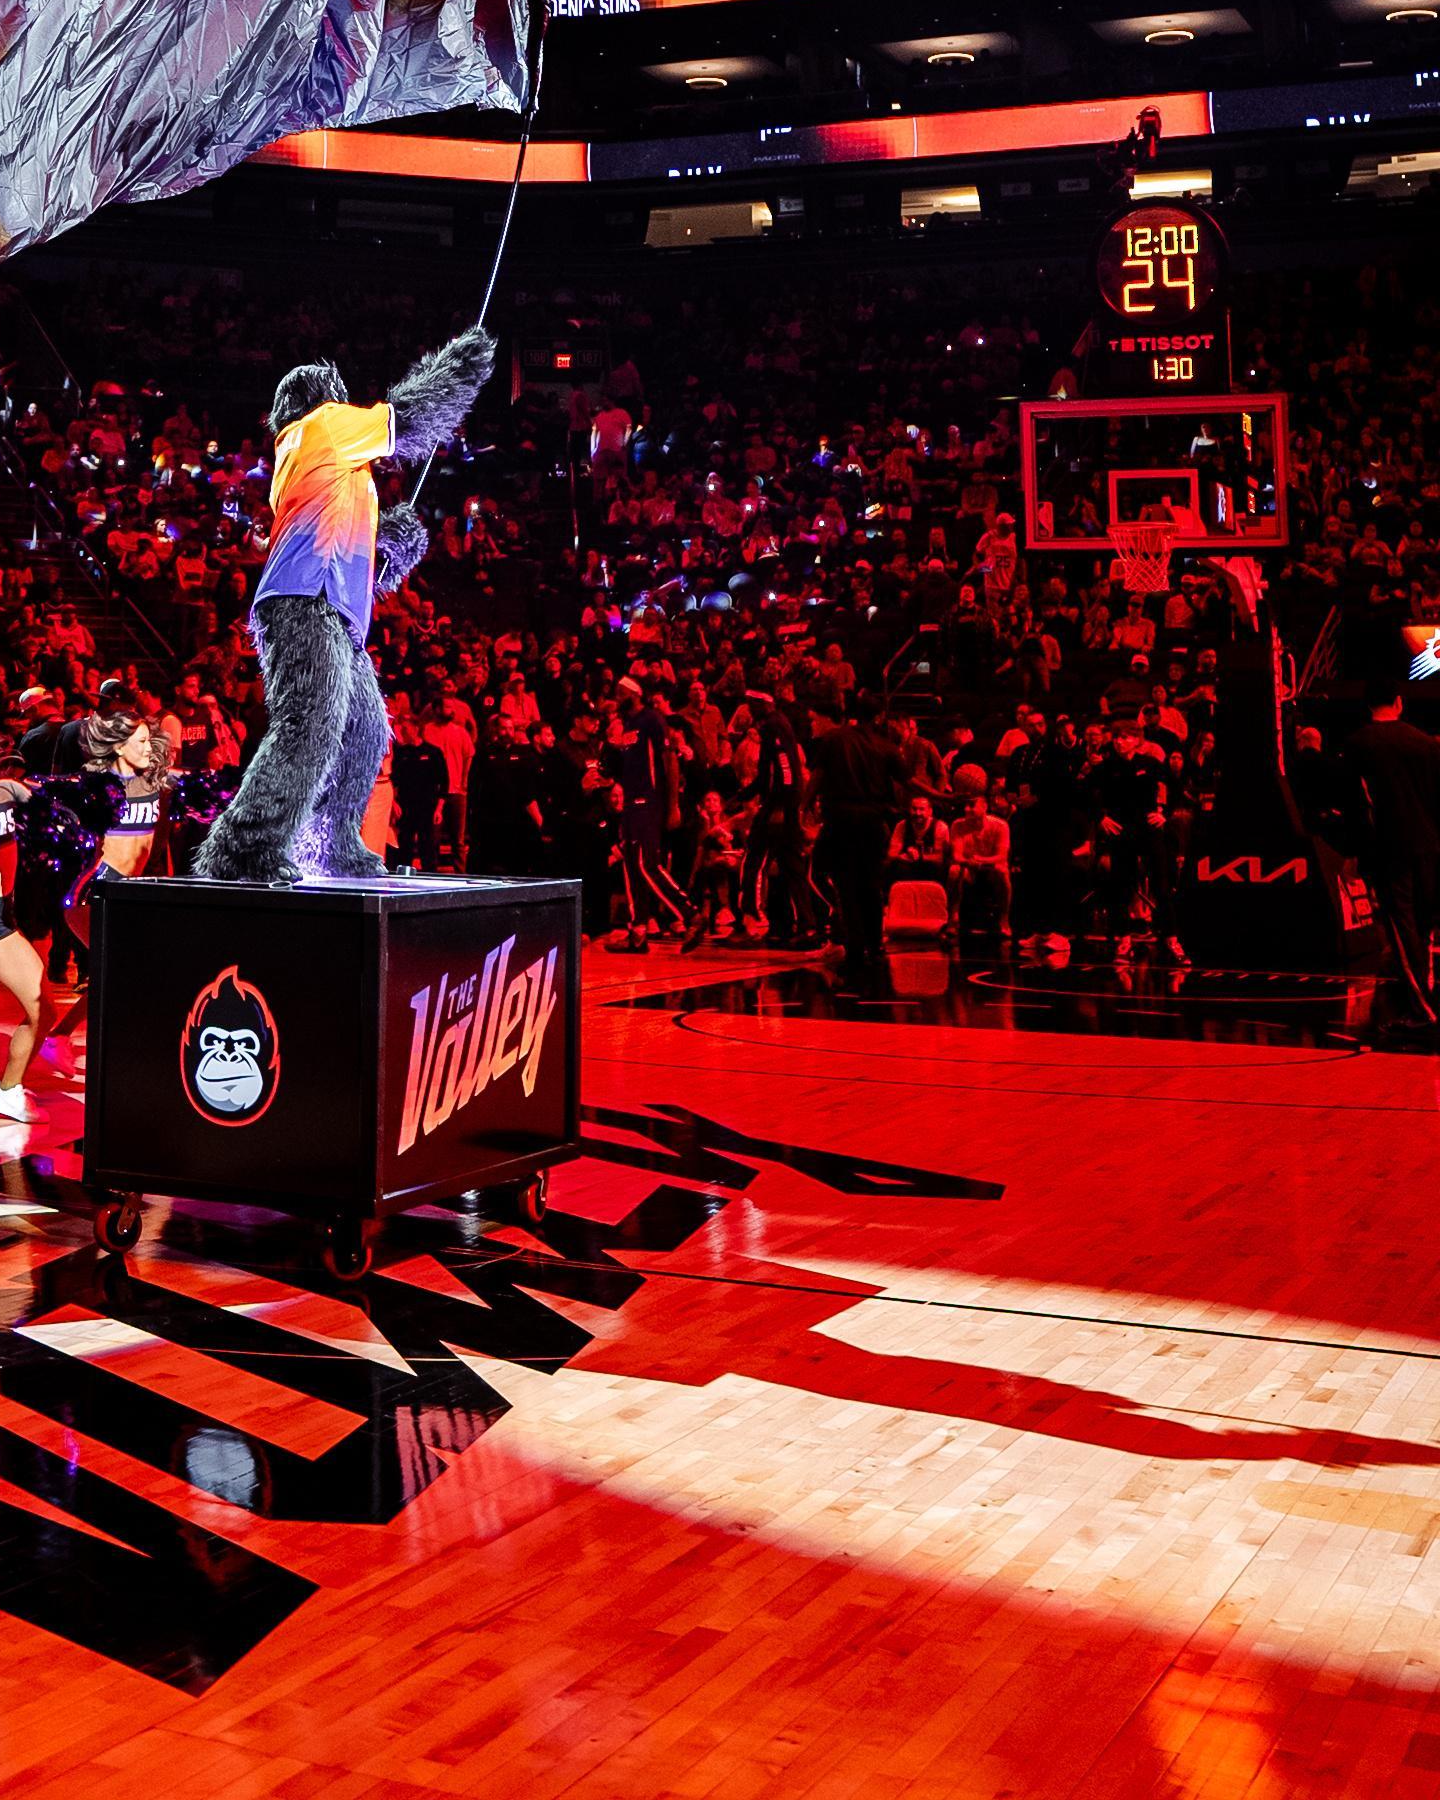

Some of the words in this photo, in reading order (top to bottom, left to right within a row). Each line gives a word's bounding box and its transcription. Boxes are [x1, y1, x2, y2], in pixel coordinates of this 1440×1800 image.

[1125, 225, 1200, 257] 12:00
[1122, 256, 1196, 313] 24
[1137, 334, 1215, 352] TISSOT
[1152, 356, 1194, 381] 1:30
[180, 725, 207, 741] ACERS
[1198, 856, 1307, 883] KIA
[448, 972, 478, 1020] THE
[397, 933, 558, 1156] Valley
